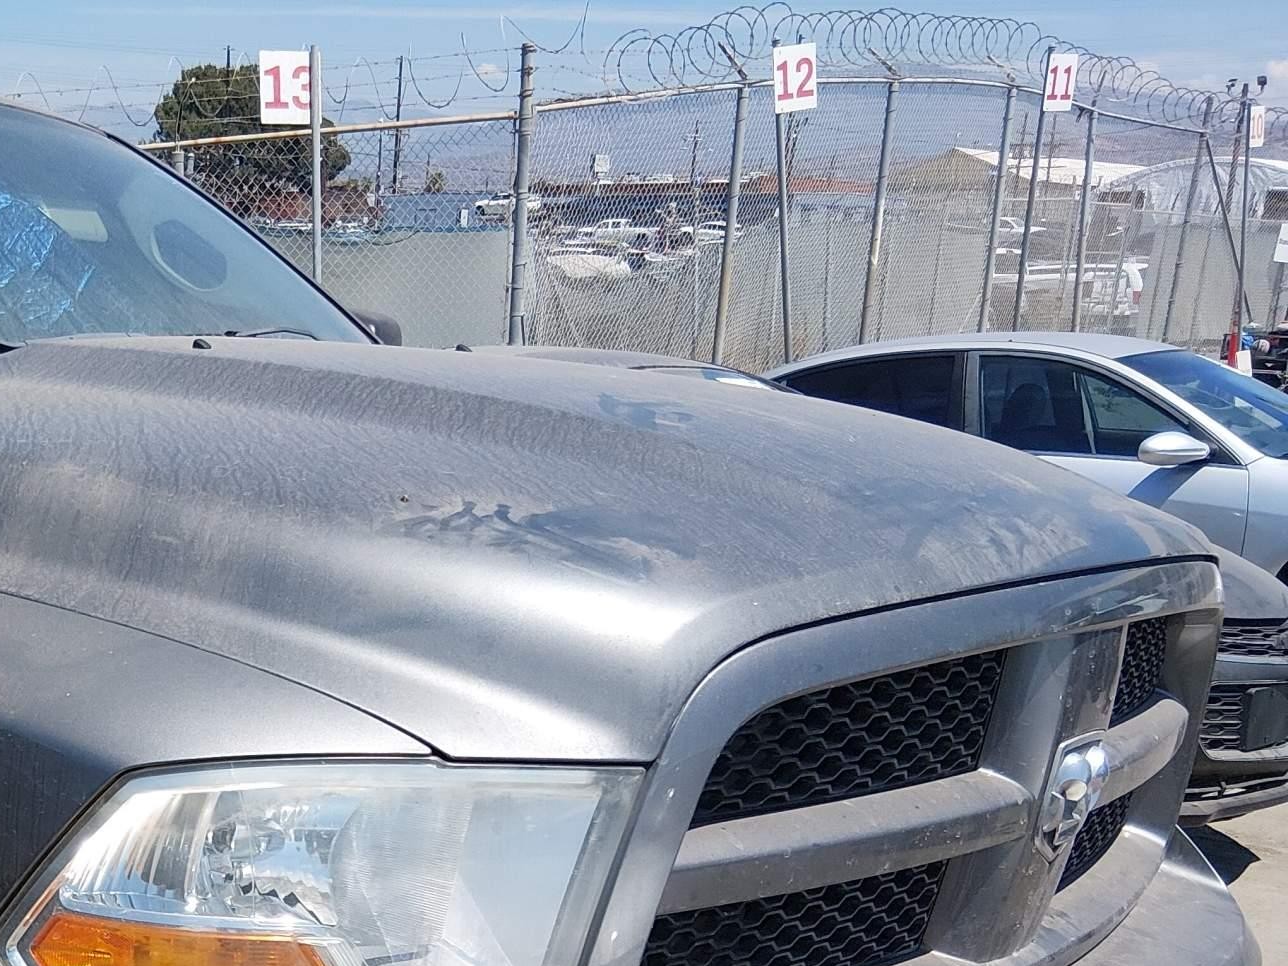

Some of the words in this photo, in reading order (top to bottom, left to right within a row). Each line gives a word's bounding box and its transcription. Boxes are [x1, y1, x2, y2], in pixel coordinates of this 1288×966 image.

[777, 57, 814, 101] 12
[1046, 65, 1072, 100] 11
[1250, 113, 1263, 139] 10
